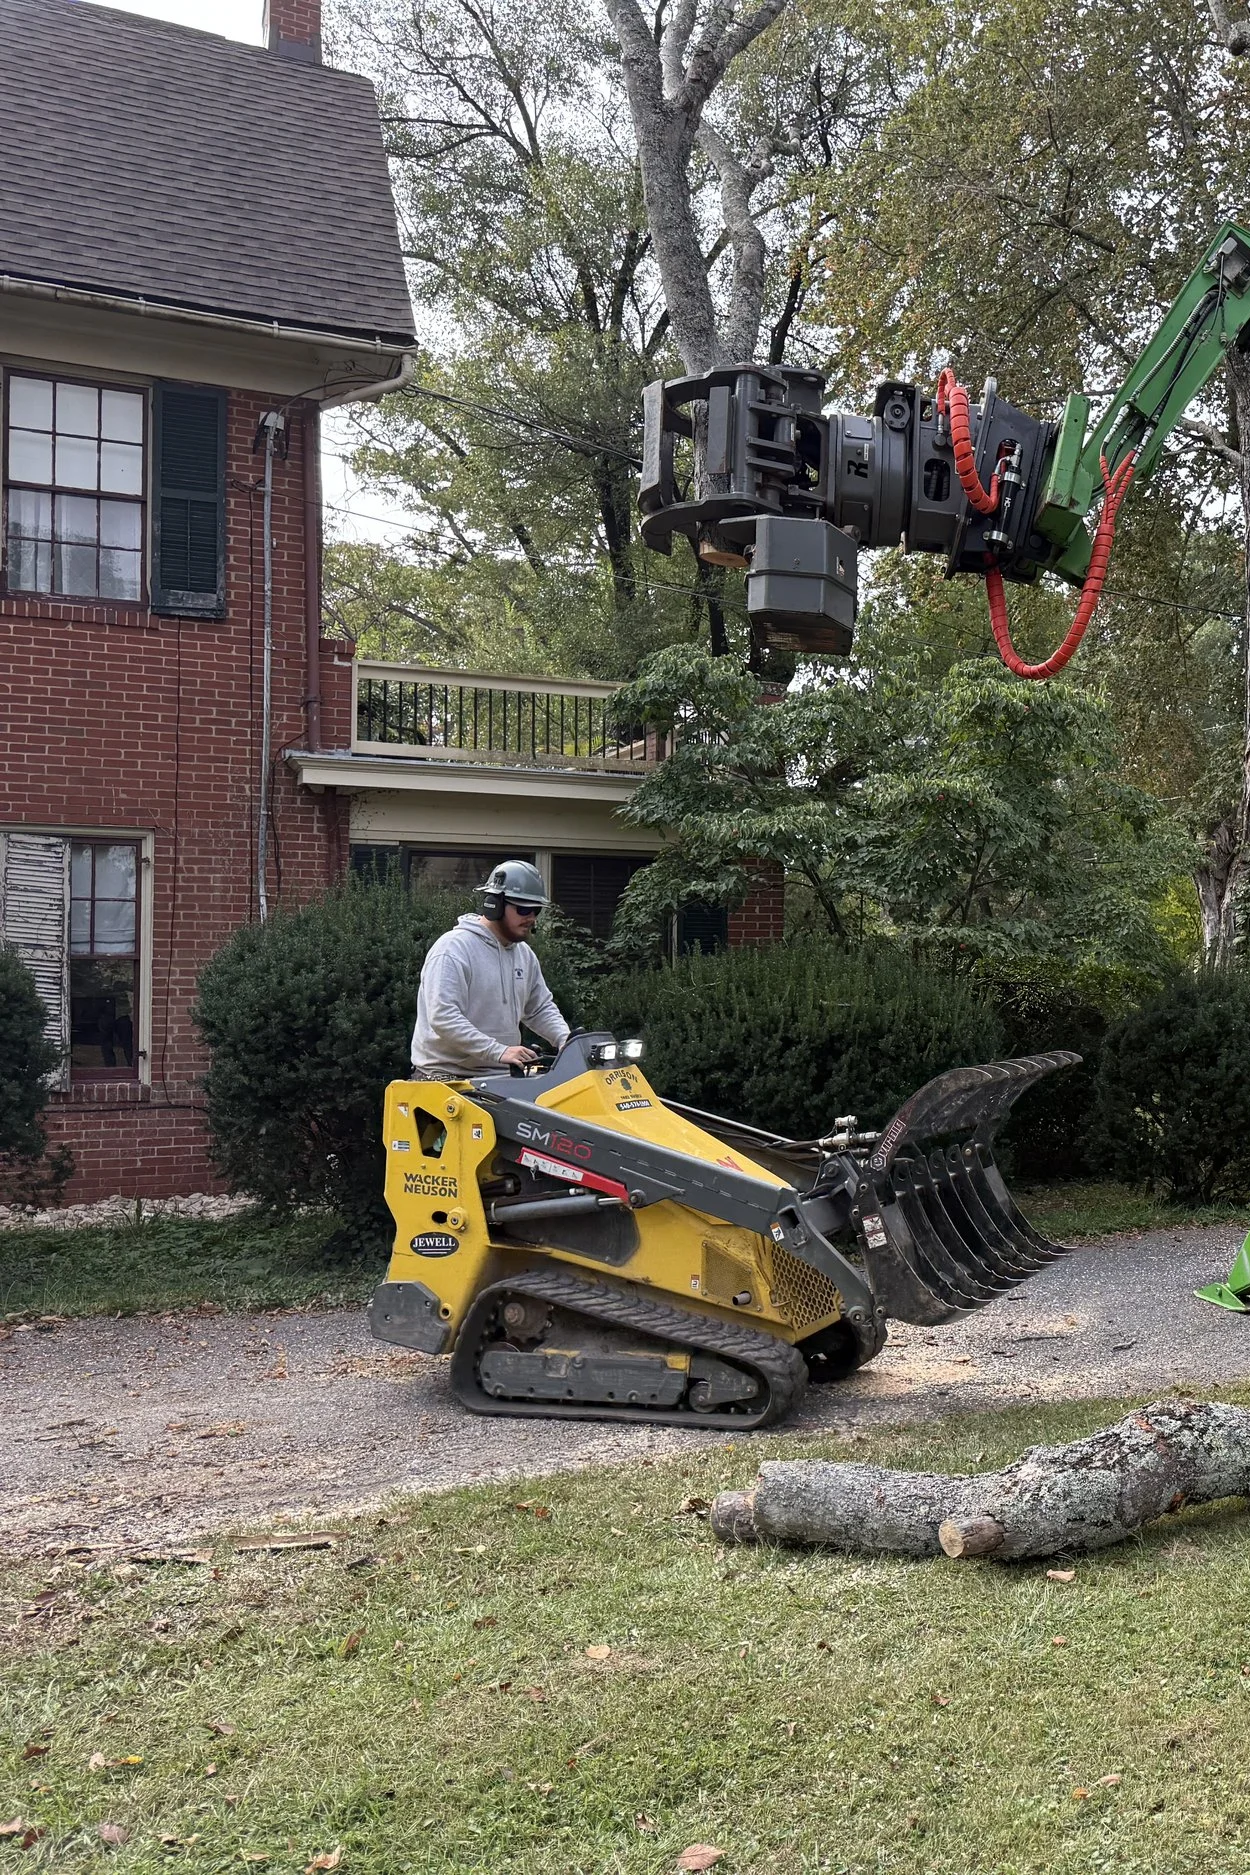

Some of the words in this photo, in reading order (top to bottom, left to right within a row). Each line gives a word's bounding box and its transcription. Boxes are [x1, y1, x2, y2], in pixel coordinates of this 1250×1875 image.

[605, 1069, 638, 1085] ORRISON
[516, 1122, 592, 1160] SM120
[403, 1172, 458, 1188] WACKER
[403, 1183, 458, 1199] NEUSON
[412, 1237, 456, 1248] JEWELL
